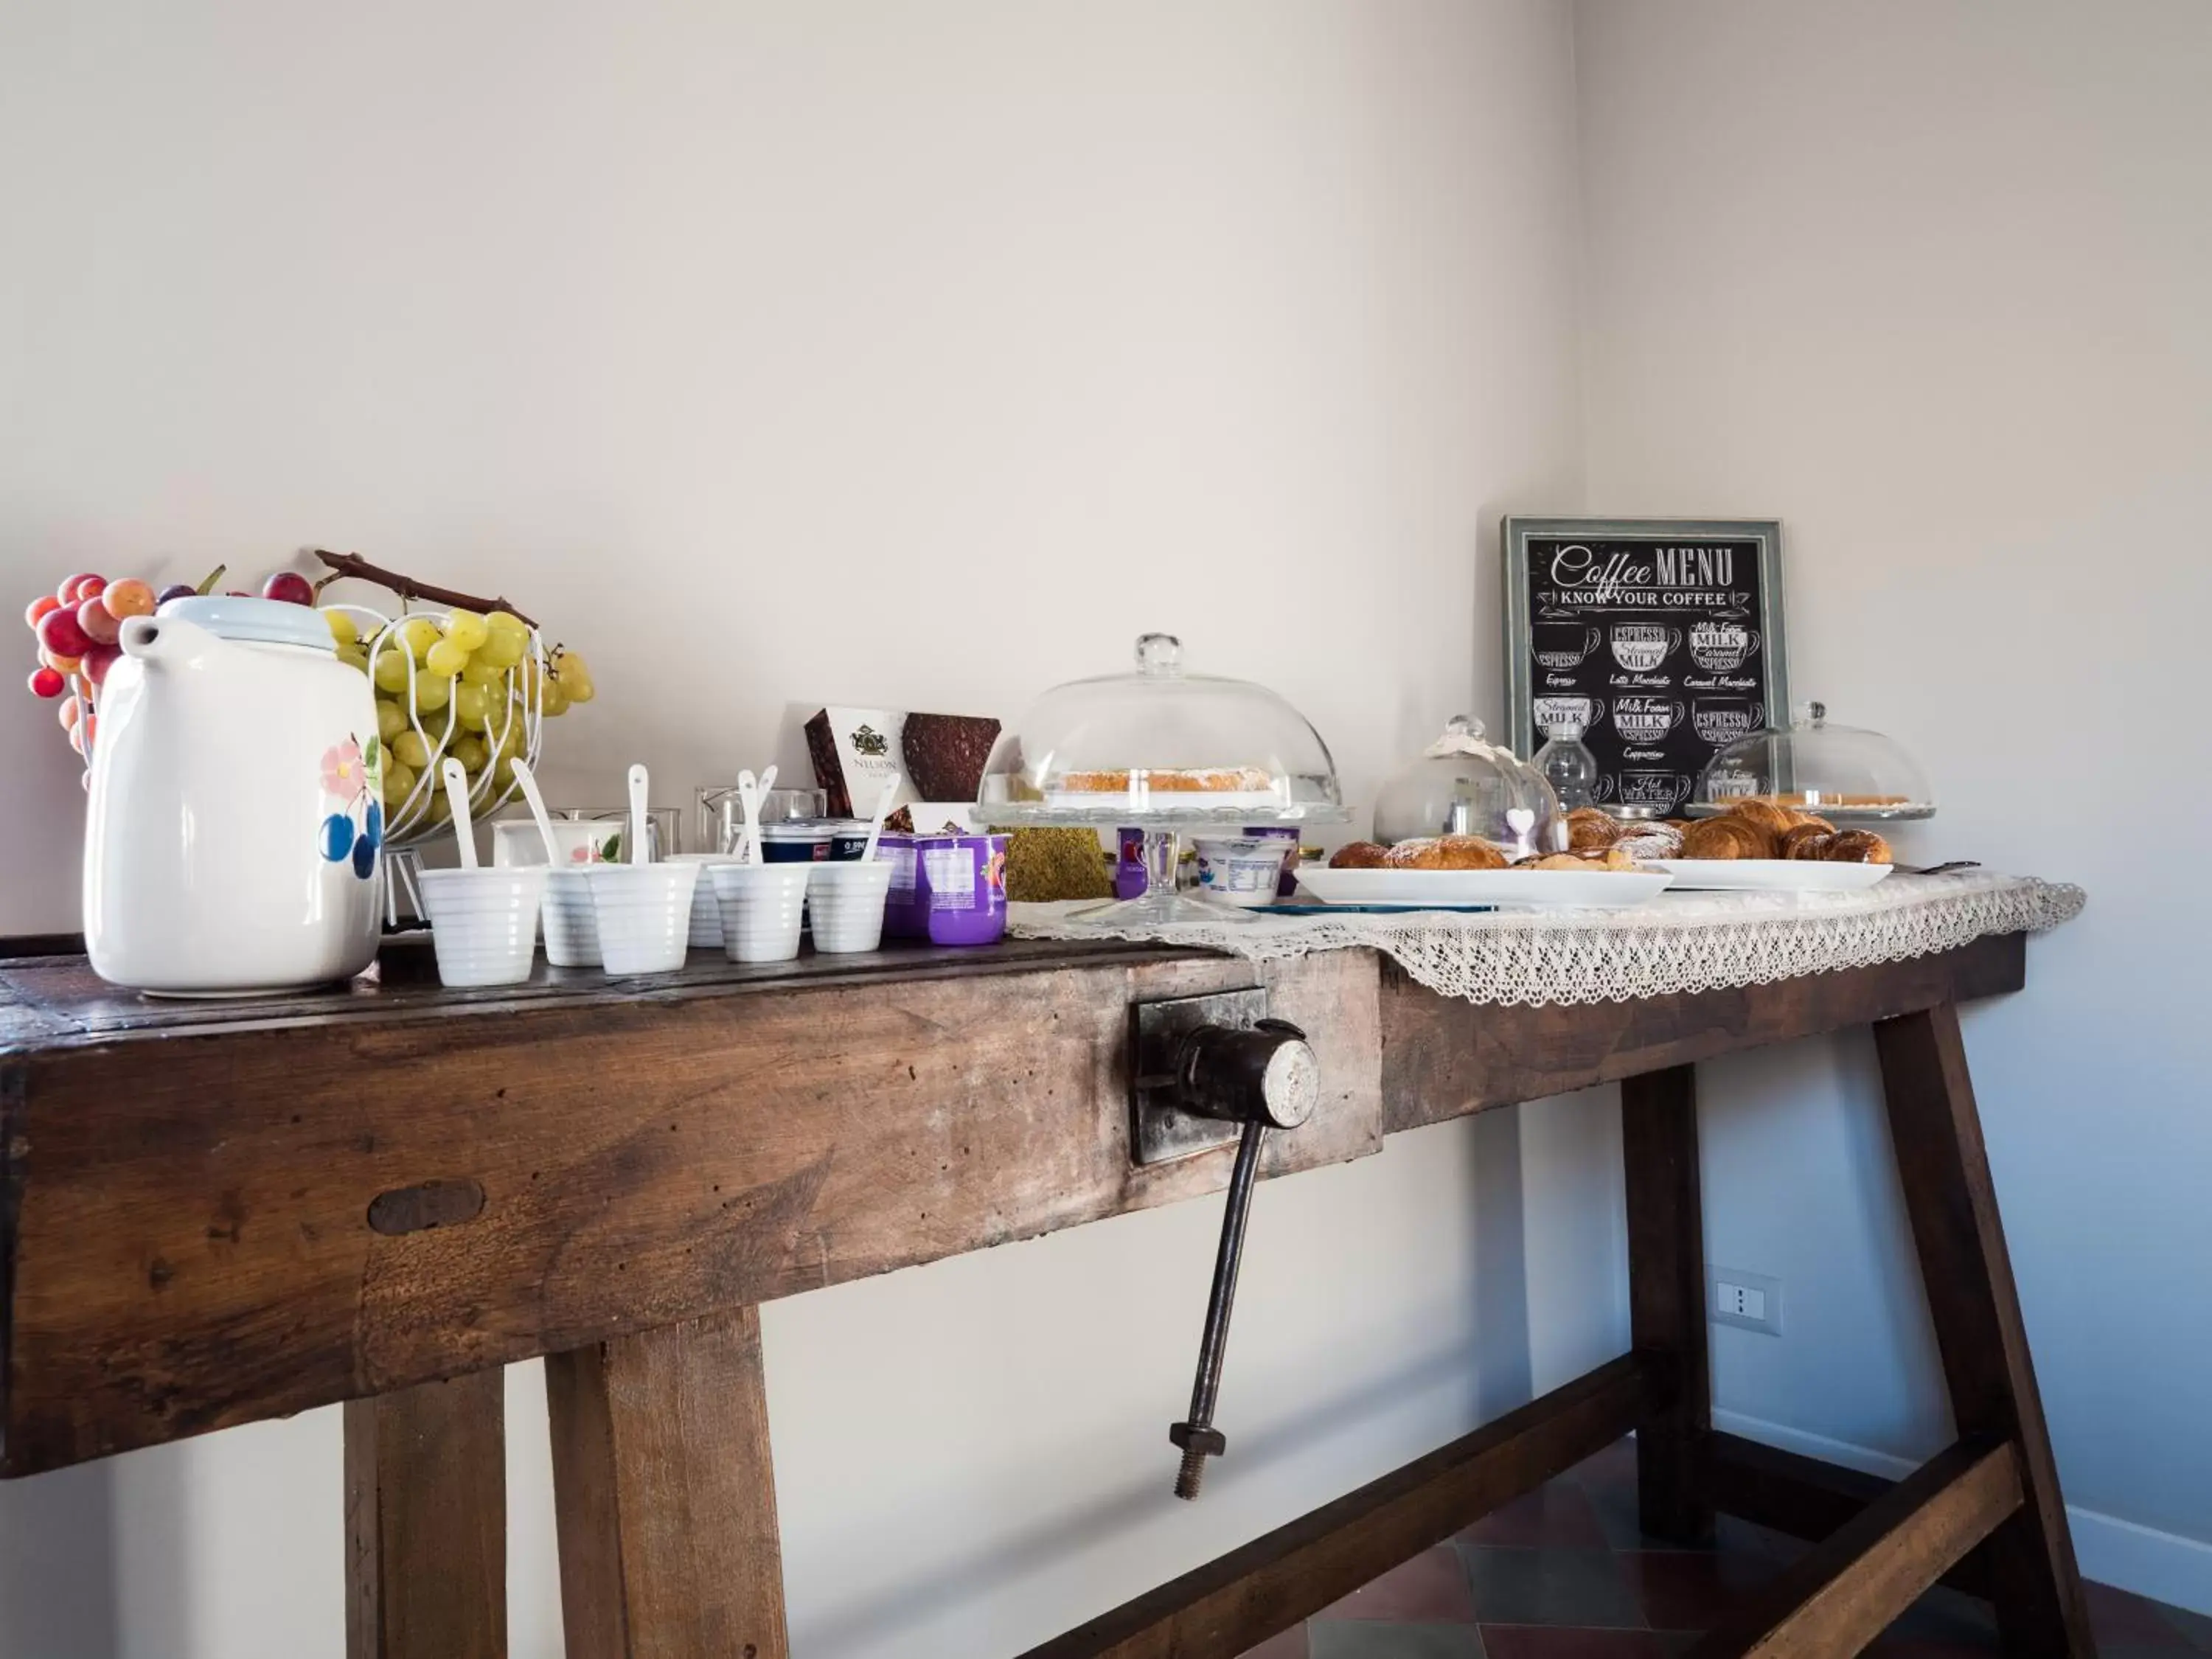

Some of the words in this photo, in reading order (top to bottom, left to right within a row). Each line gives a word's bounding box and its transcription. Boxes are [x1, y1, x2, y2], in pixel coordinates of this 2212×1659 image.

[1551, 544, 1652, 599] Coffee
[1655, 548, 1733, 586] MENU
[1561, 591, 1607, 605] KNOW
[1614, 591, 1658, 605] YOUR
[1663, 592, 1726, 605] COFFEE
[1615, 627, 1666, 642] ESPRESSO
[1697, 634, 1739, 646] MILK
[1538, 652, 1580, 667] ESPRESSO
[1618, 654, 1658, 667] MILK
[1698, 657, 1740, 670] ESPRESSO
[1616, 698, 1644, 713] Milk
[1644, 698, 1670, 713] Foam
[1540, 712, 1582, 723] MILK
[1621, 715, 1664, 728] MILK
[1697, 712, 1749, 728] ESPRESSO
[1623, 728, 1665, 741] ESPRESSO
[1632, 776, 1663, 791] Hot
